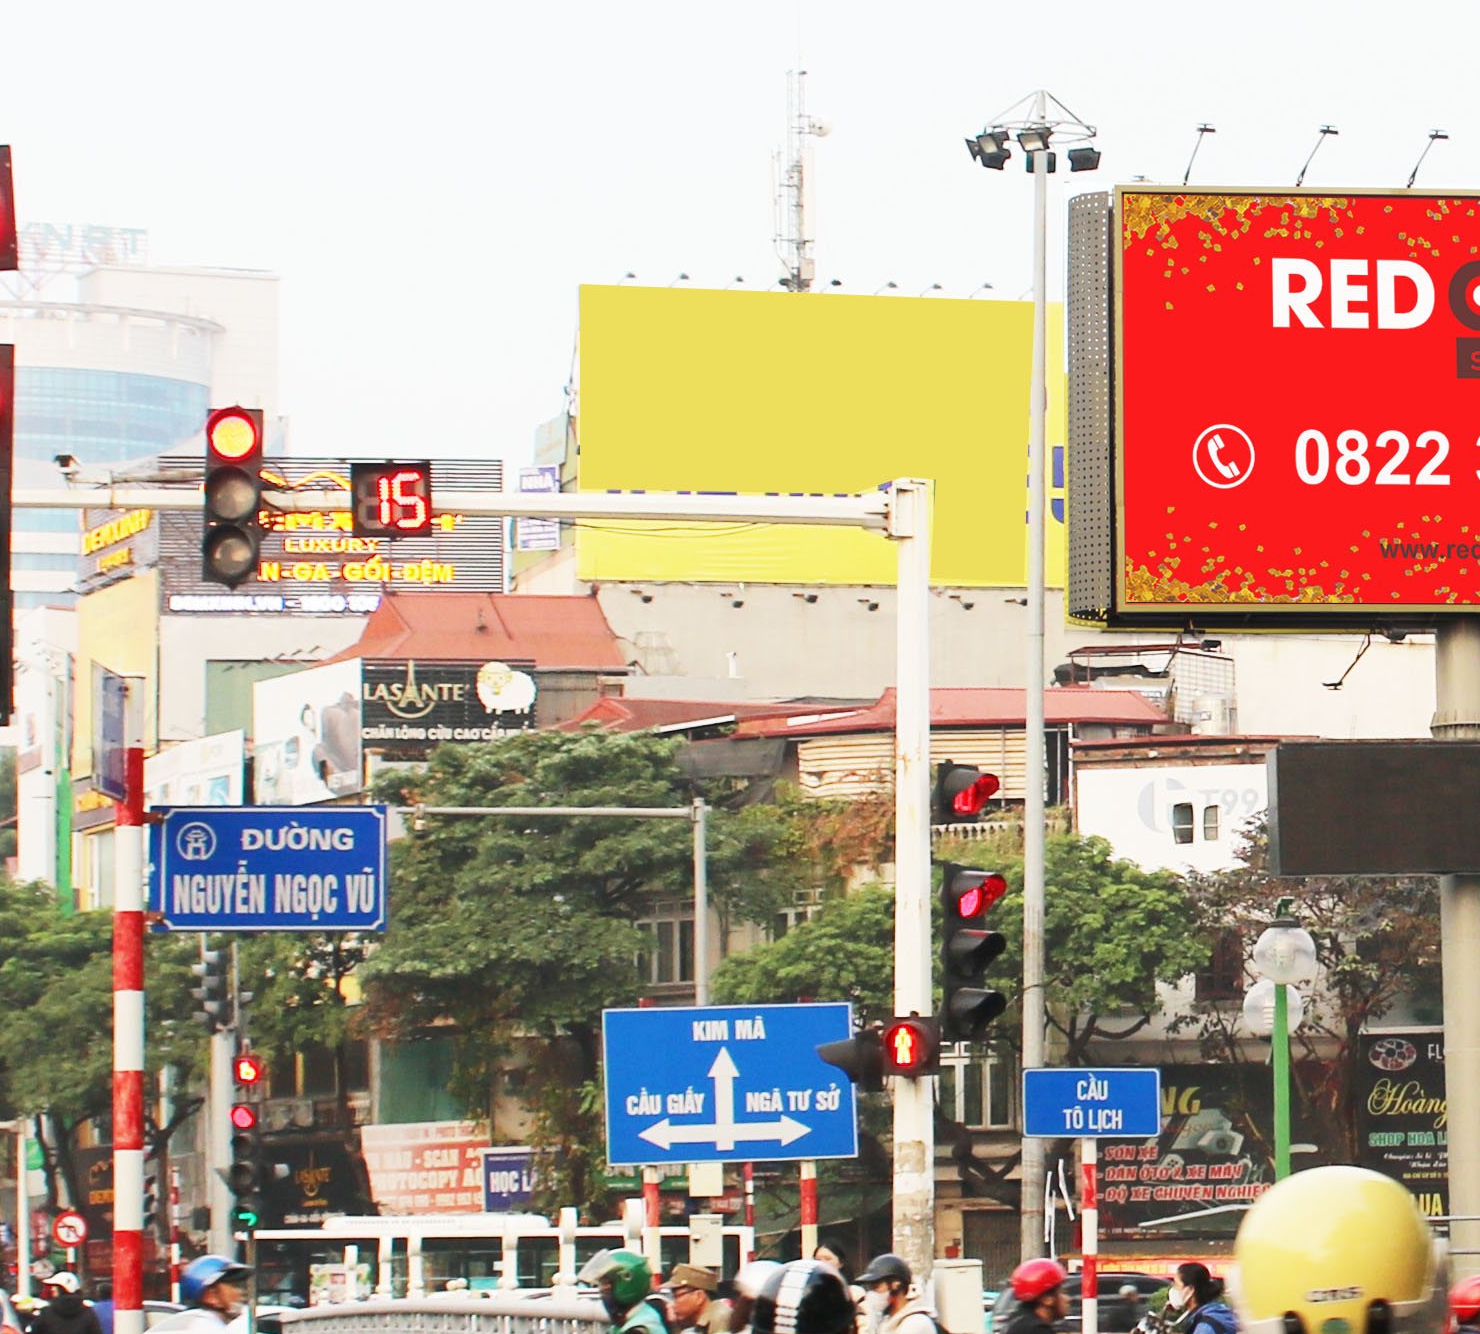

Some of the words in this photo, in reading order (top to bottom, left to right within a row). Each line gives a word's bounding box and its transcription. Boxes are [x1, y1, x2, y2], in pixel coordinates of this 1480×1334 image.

[1272, 257, 1435, 329] RED
[1294, 429, 1451, 486] 0822
[377, 472, 427, 530] 15
[284, 537, 380, 553] LUXURY
[454, 728, 480, 740] CAO
[240, 820, 355, 852] ĐƯỜNG
[173, 860, 266, 915] NGUYỄN
[274, 873, 338, 921] NGỌC
[345, 867, 375, 914] VŨ
[692, 1020, 729, 1042] KIM
[734, 1015, 766, 1041] MÃ
[745, 1088, 783, 1113] NGÃ
[787, 1088, 812, 1113] TƯ
[815, 1082, 841, 1112] SỞ
[1076, 1073, 1108, 1101] CẦU
[625, 1087, 662, 1116] CẦU
[666, 1086, 705, 1115] GIẤY
[1063, 1106, 1084, 1130] TÔ
[1088, 1108, 1123, 1133] LỊCH
[1137, 1145, 1159, 1160] XE
[1368, 1132, 1405, 1147] SHOP
[1407, 1131, 1435, 1147] HOA
[423, 1148, 459, 1168] SCAN
[1186, 1164, 1207, 1179] XE
[1209, 1163, 1244, 1179] MÁY
[489, 1171, 519, 1197] HỌC
[1131, 1186, 1153, 1201] XE
[1153, 1183, 1214, 1202] CHUYÊN
